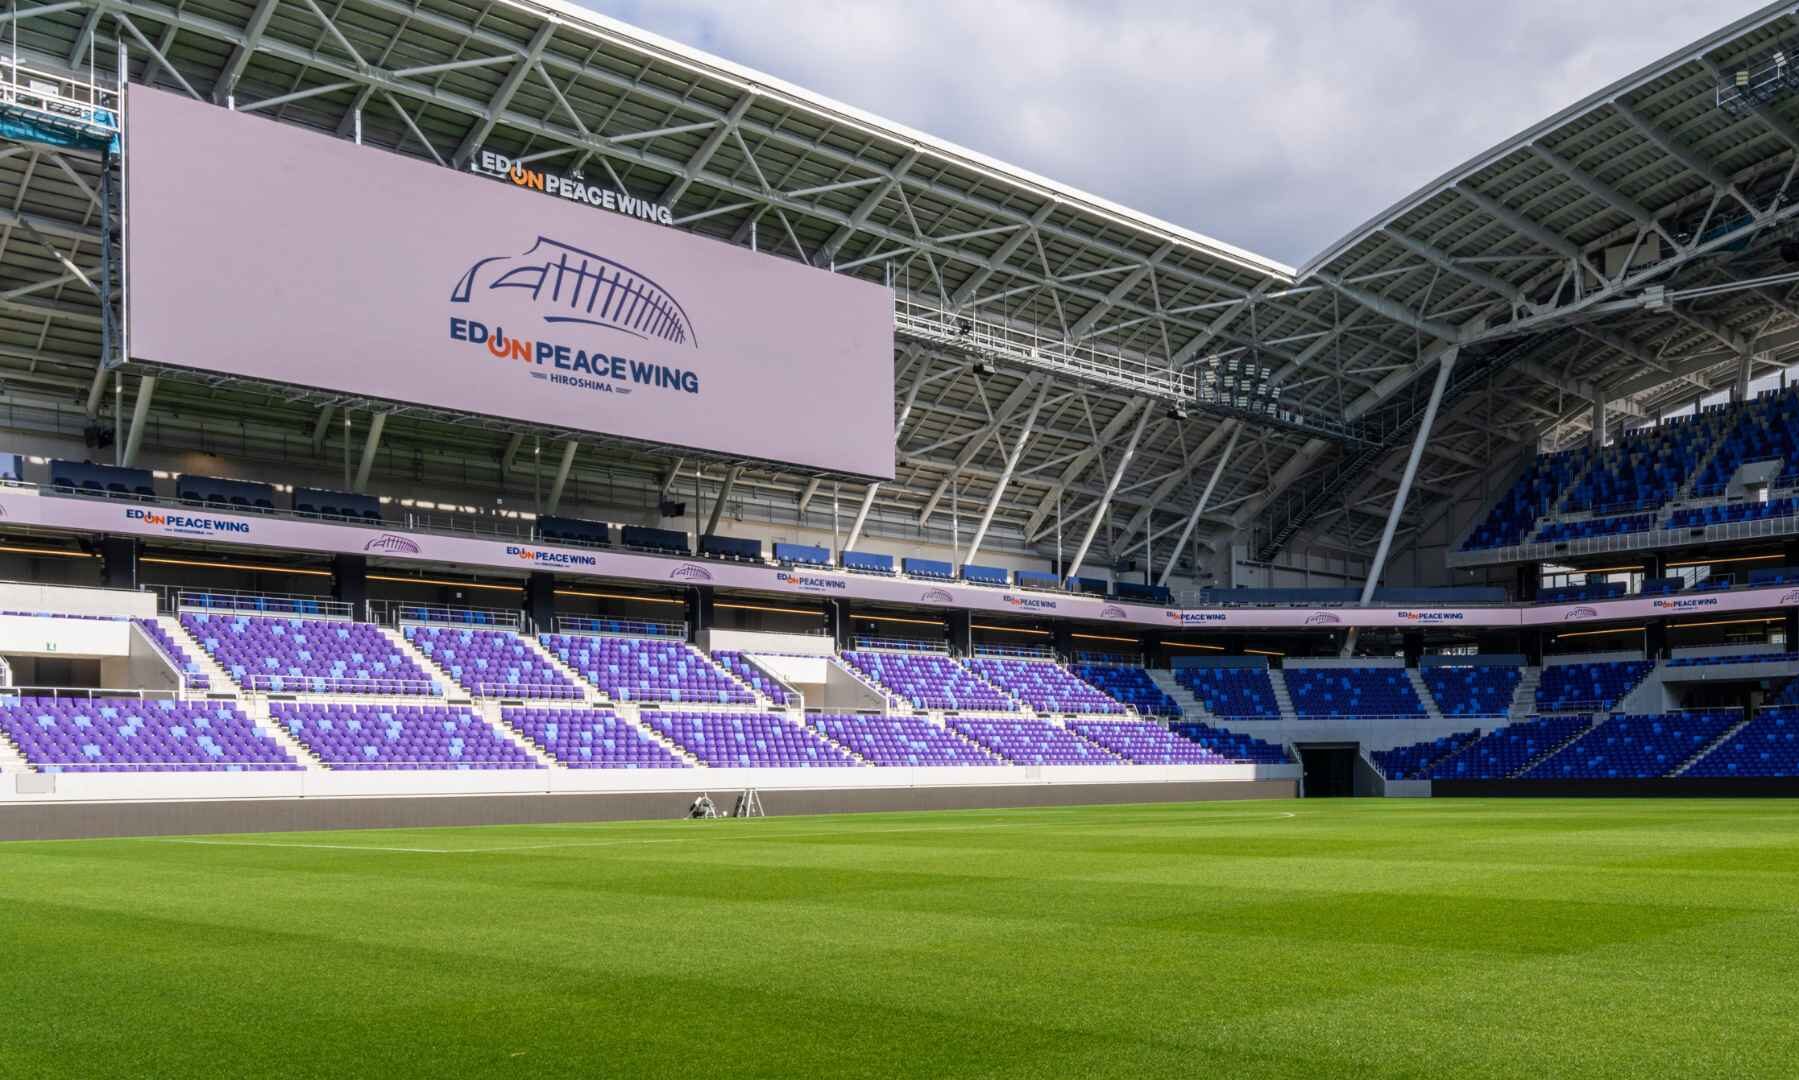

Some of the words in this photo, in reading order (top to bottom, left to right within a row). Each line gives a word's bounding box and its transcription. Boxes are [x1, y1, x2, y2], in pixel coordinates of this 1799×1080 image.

[545, 173, 615, 210] PEACE
[616, 197, 673, 225] WING
[536, 341, 627, 380] PEACE
[630, 360, 699, 394] WING
[550, 374, 613, 393] HIROSHIMA
[166, 515, 212, 530] PEACE
[213, 519, 250, 533] WING
[536, 551, 569, 563] PEACE
[569, 554, 597, 565] WING
[799, 577, 825, 587] PEACE
[825, 580, 846, 589] WING
[1041, 599, 1057, 609] WING
